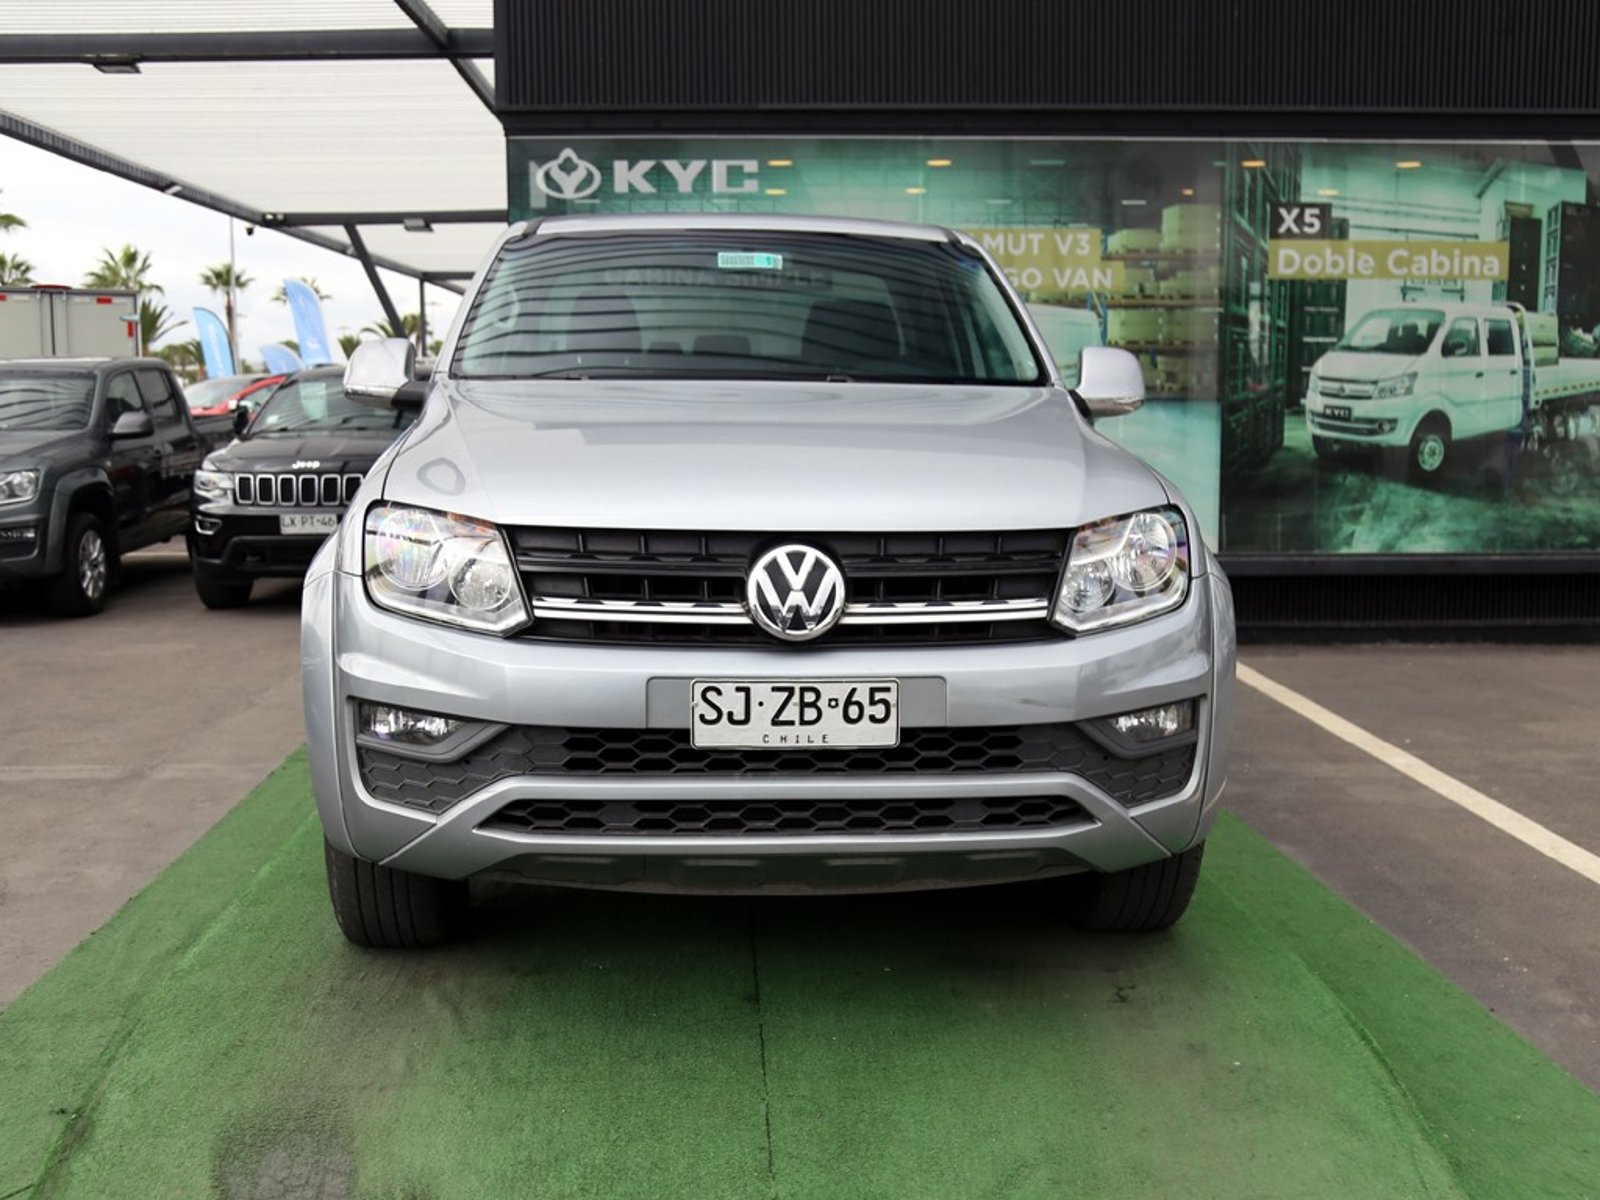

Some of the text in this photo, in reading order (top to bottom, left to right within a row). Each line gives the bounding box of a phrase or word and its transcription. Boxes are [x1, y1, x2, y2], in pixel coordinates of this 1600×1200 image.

[613, 159, 759, 194] KYC
[1278, 207, 1321, 234] X5
[977, 231, 1091, 257] MUT V3
[1278, 248, 1500, 276] Doble Cabina
[1053, 267, 1113, 289] VAN
[292, 460, 320, 469] Jeep
[762, 734, 829, 744] CHILE
